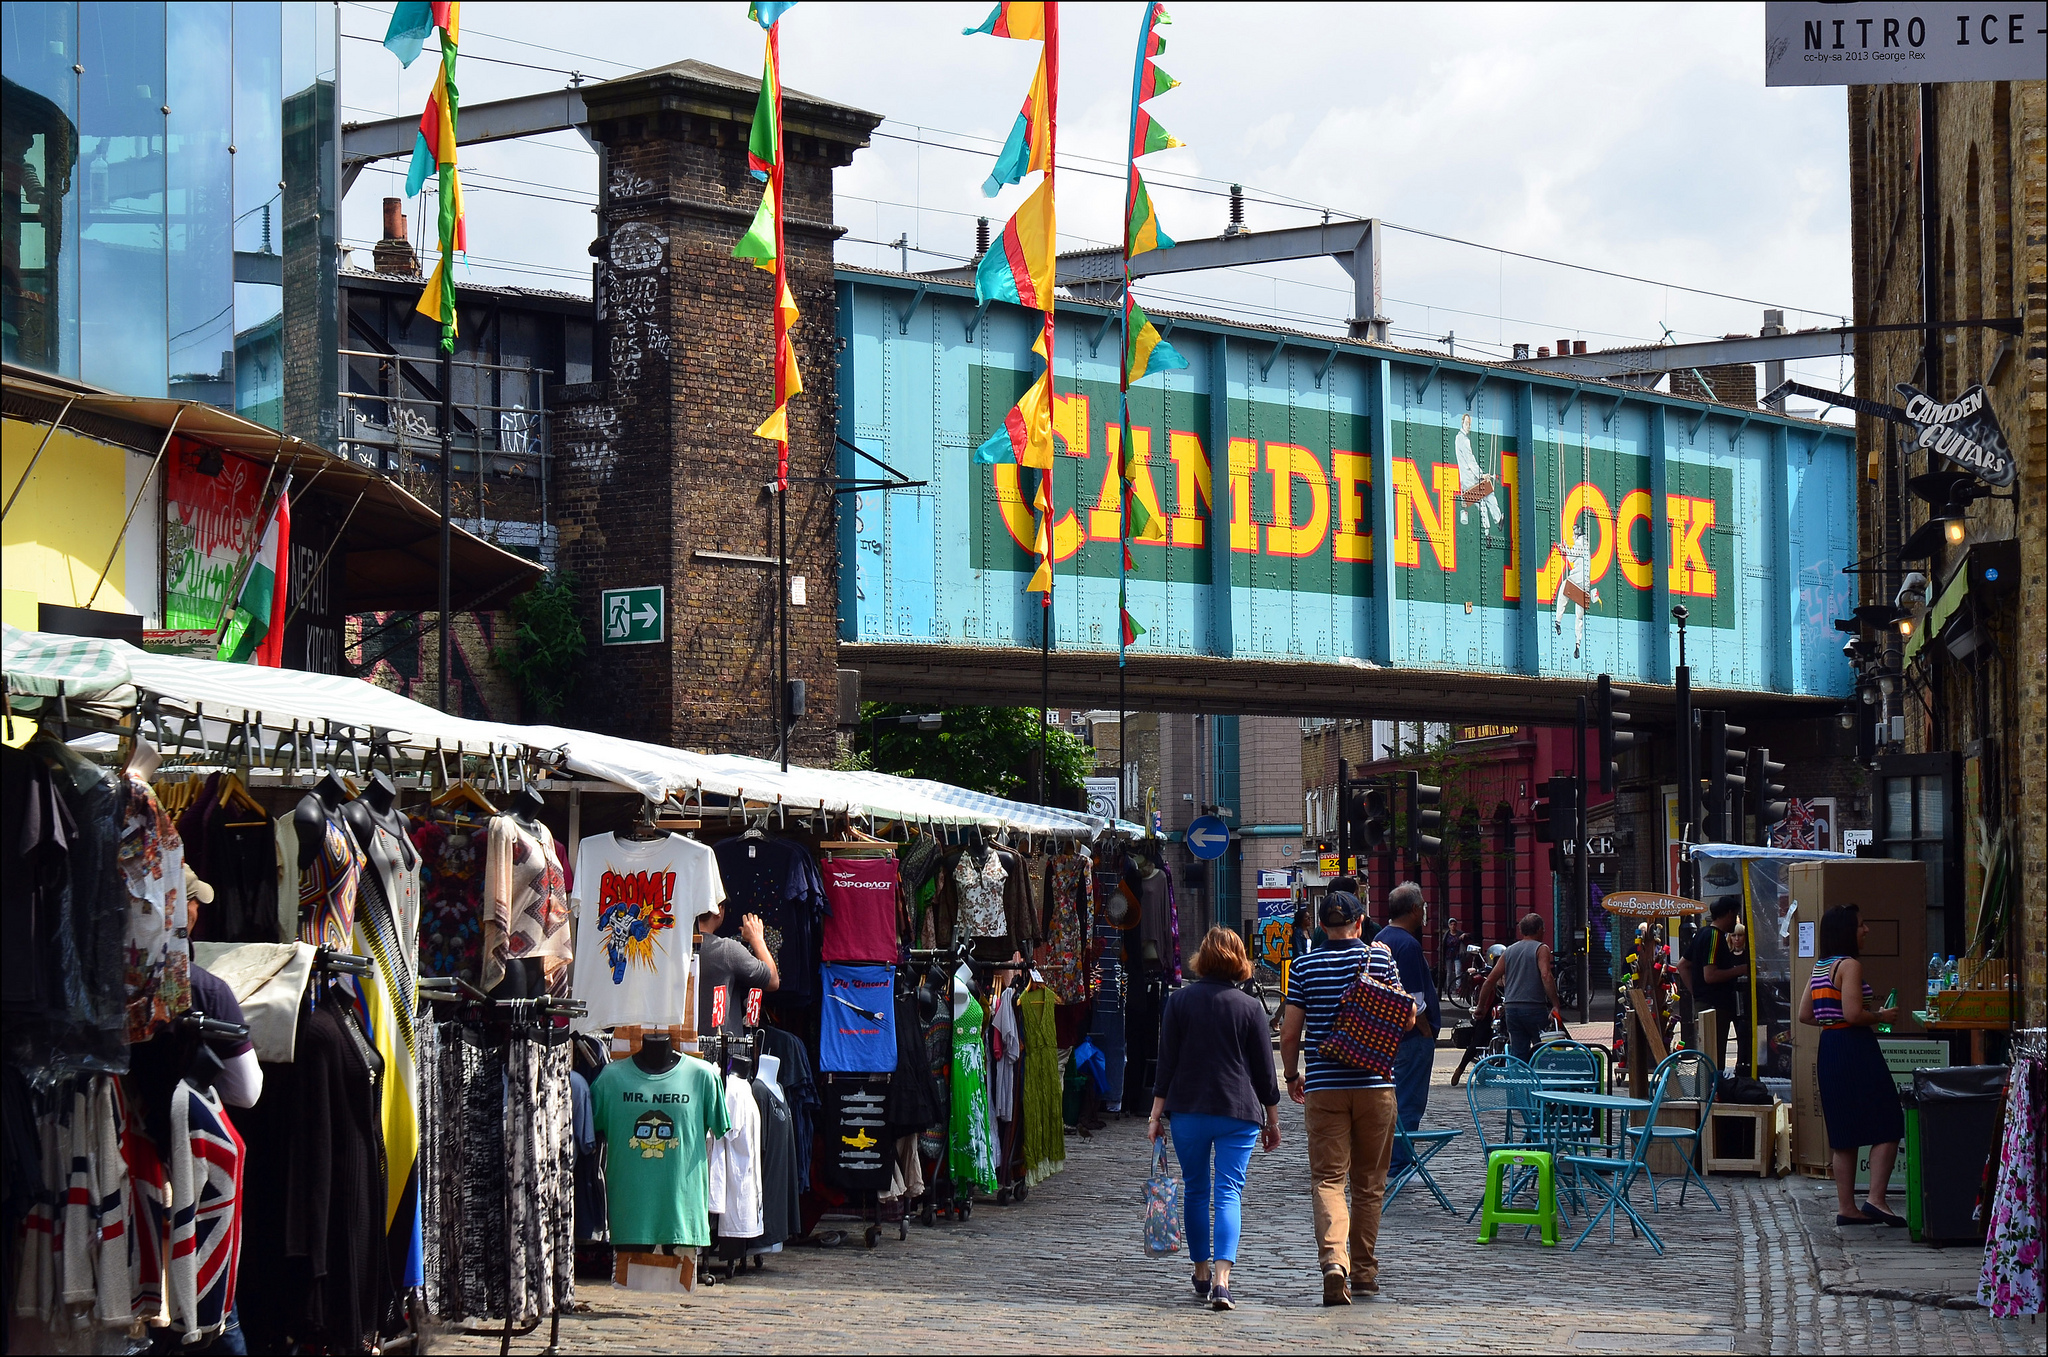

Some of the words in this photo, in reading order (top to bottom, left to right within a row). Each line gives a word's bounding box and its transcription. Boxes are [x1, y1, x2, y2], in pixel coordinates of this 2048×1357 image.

[1804, 17, 1926, 50] NITRO
[1905, 388, 1984, 425] CAMDEN
[1917, 423, 2006, 473] GUITARS
[994, 393, 1462, 572] CAMDEN
[1501, 451, 1717, 605] LOCK
[291, 542, 330, 616] NEPALI
[1464, 727, 1476, 739] THE
[1282, 844, 1292, 856] C
[599, 871, 676, 914] BOOM!
[833, 880, 892, 889] АЭРОФЛОТ
[1607, 897, 1696, 911] LongBoardsUK.com
[832, 977, 849, 990] Fly
[712, 992, 725, 1023] £3
[747, 990, 762, 1023] £5
[623, 1091, 648, 1103] MR.
[652, 1093, 690, 1104] NERD
